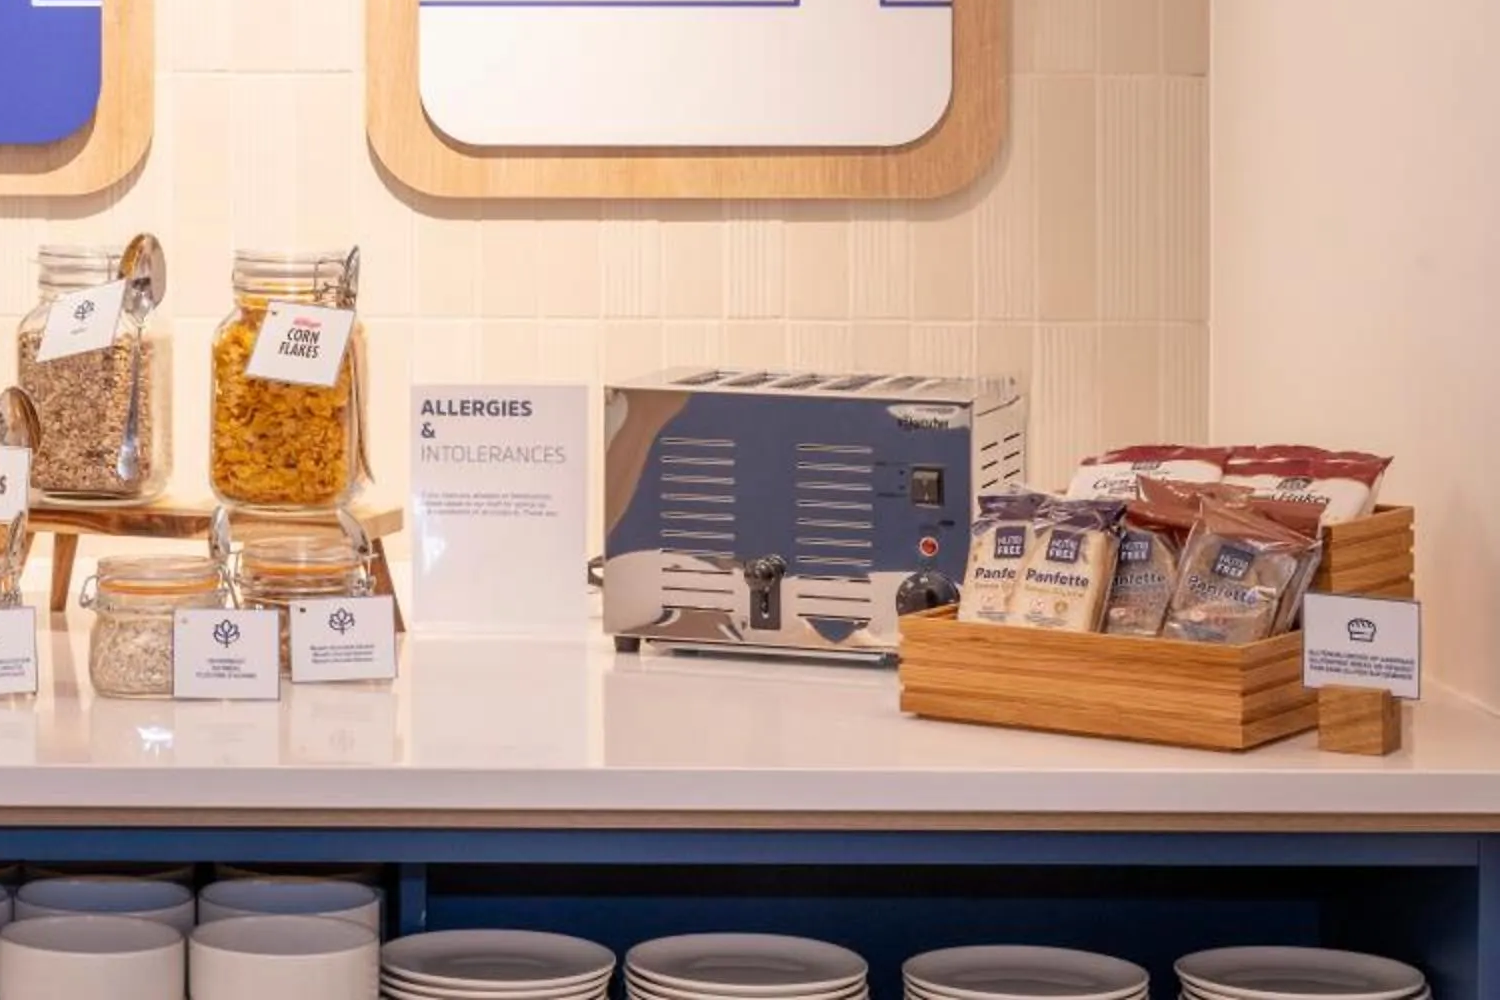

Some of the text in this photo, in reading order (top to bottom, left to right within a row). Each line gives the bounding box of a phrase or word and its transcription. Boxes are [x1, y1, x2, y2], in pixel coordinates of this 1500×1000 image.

[287, 327, 321, 344] CORN
[278, 341, 320, 359] FLAKES
[420, 398, 533, 417] ALLERGIES
[420, 422, 436, 439] &
[420, 444, 567, 464] INTOLERANCES
[996, 545, 1022, 556] FREE
[1049, 547, 1076, 560] FREE
[1121, 550, 1147, 561] FREE
[975, 567, 1016, 580] Panfe
[1216, 563, 1245, 578] FREE
